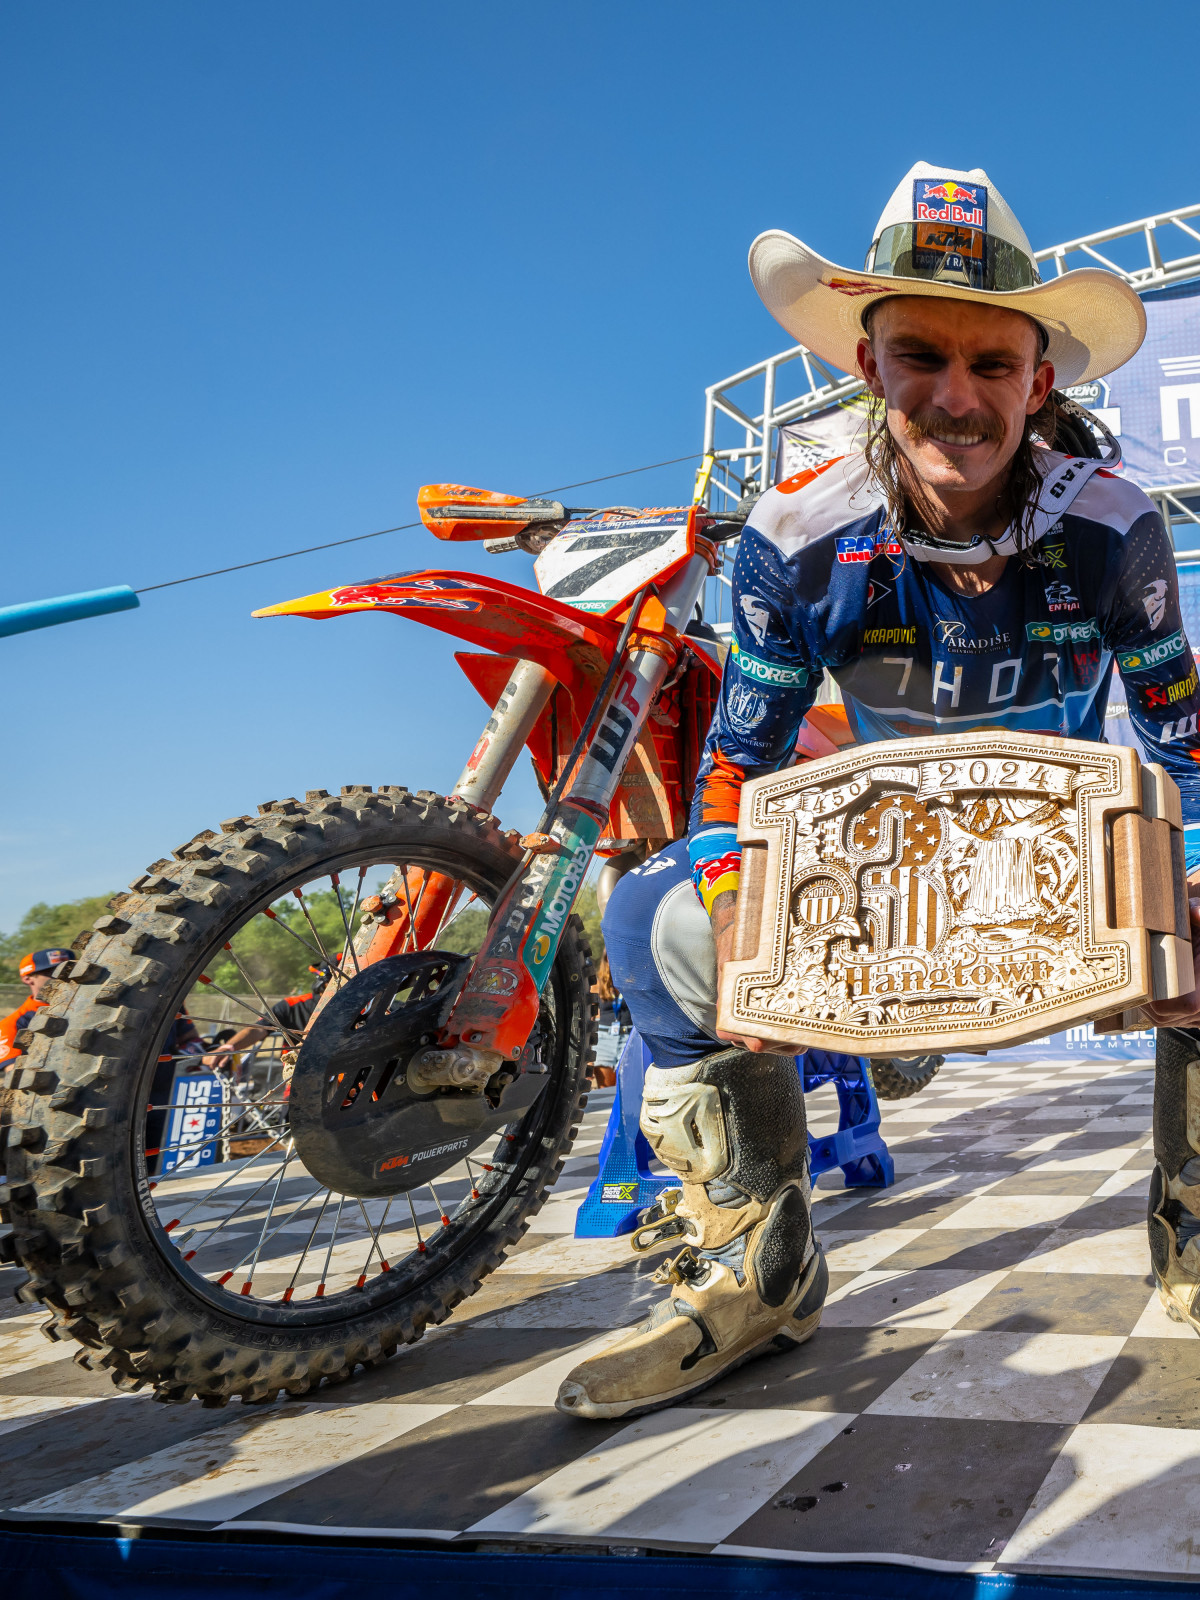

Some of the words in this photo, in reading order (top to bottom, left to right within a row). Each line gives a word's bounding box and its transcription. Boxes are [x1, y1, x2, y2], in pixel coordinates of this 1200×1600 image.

[916, 202, 950, 221] Red
[951, 205, 983, 227] Bull
[924, 230, 974, 250] KTM
[544, 529, 679, 598] 7
[862, 625, 917, 645] KRAPOVIČ
[1053, 622, 1097, 643] OTOREX
[1143, 630, 1187, 665] MOTO
[739, 654, 801, 684] OTOREX
[937, 760, 1050, 790] 2024
[812, 782, 861, 814] 450
[540, 837, 597, 935] MOTOREX
[808, 887, 834, 899] NORTH
[844, 959, 1055, 996] Hangtown
[1066, 1040, 1156, 1050] CHAMPIO
